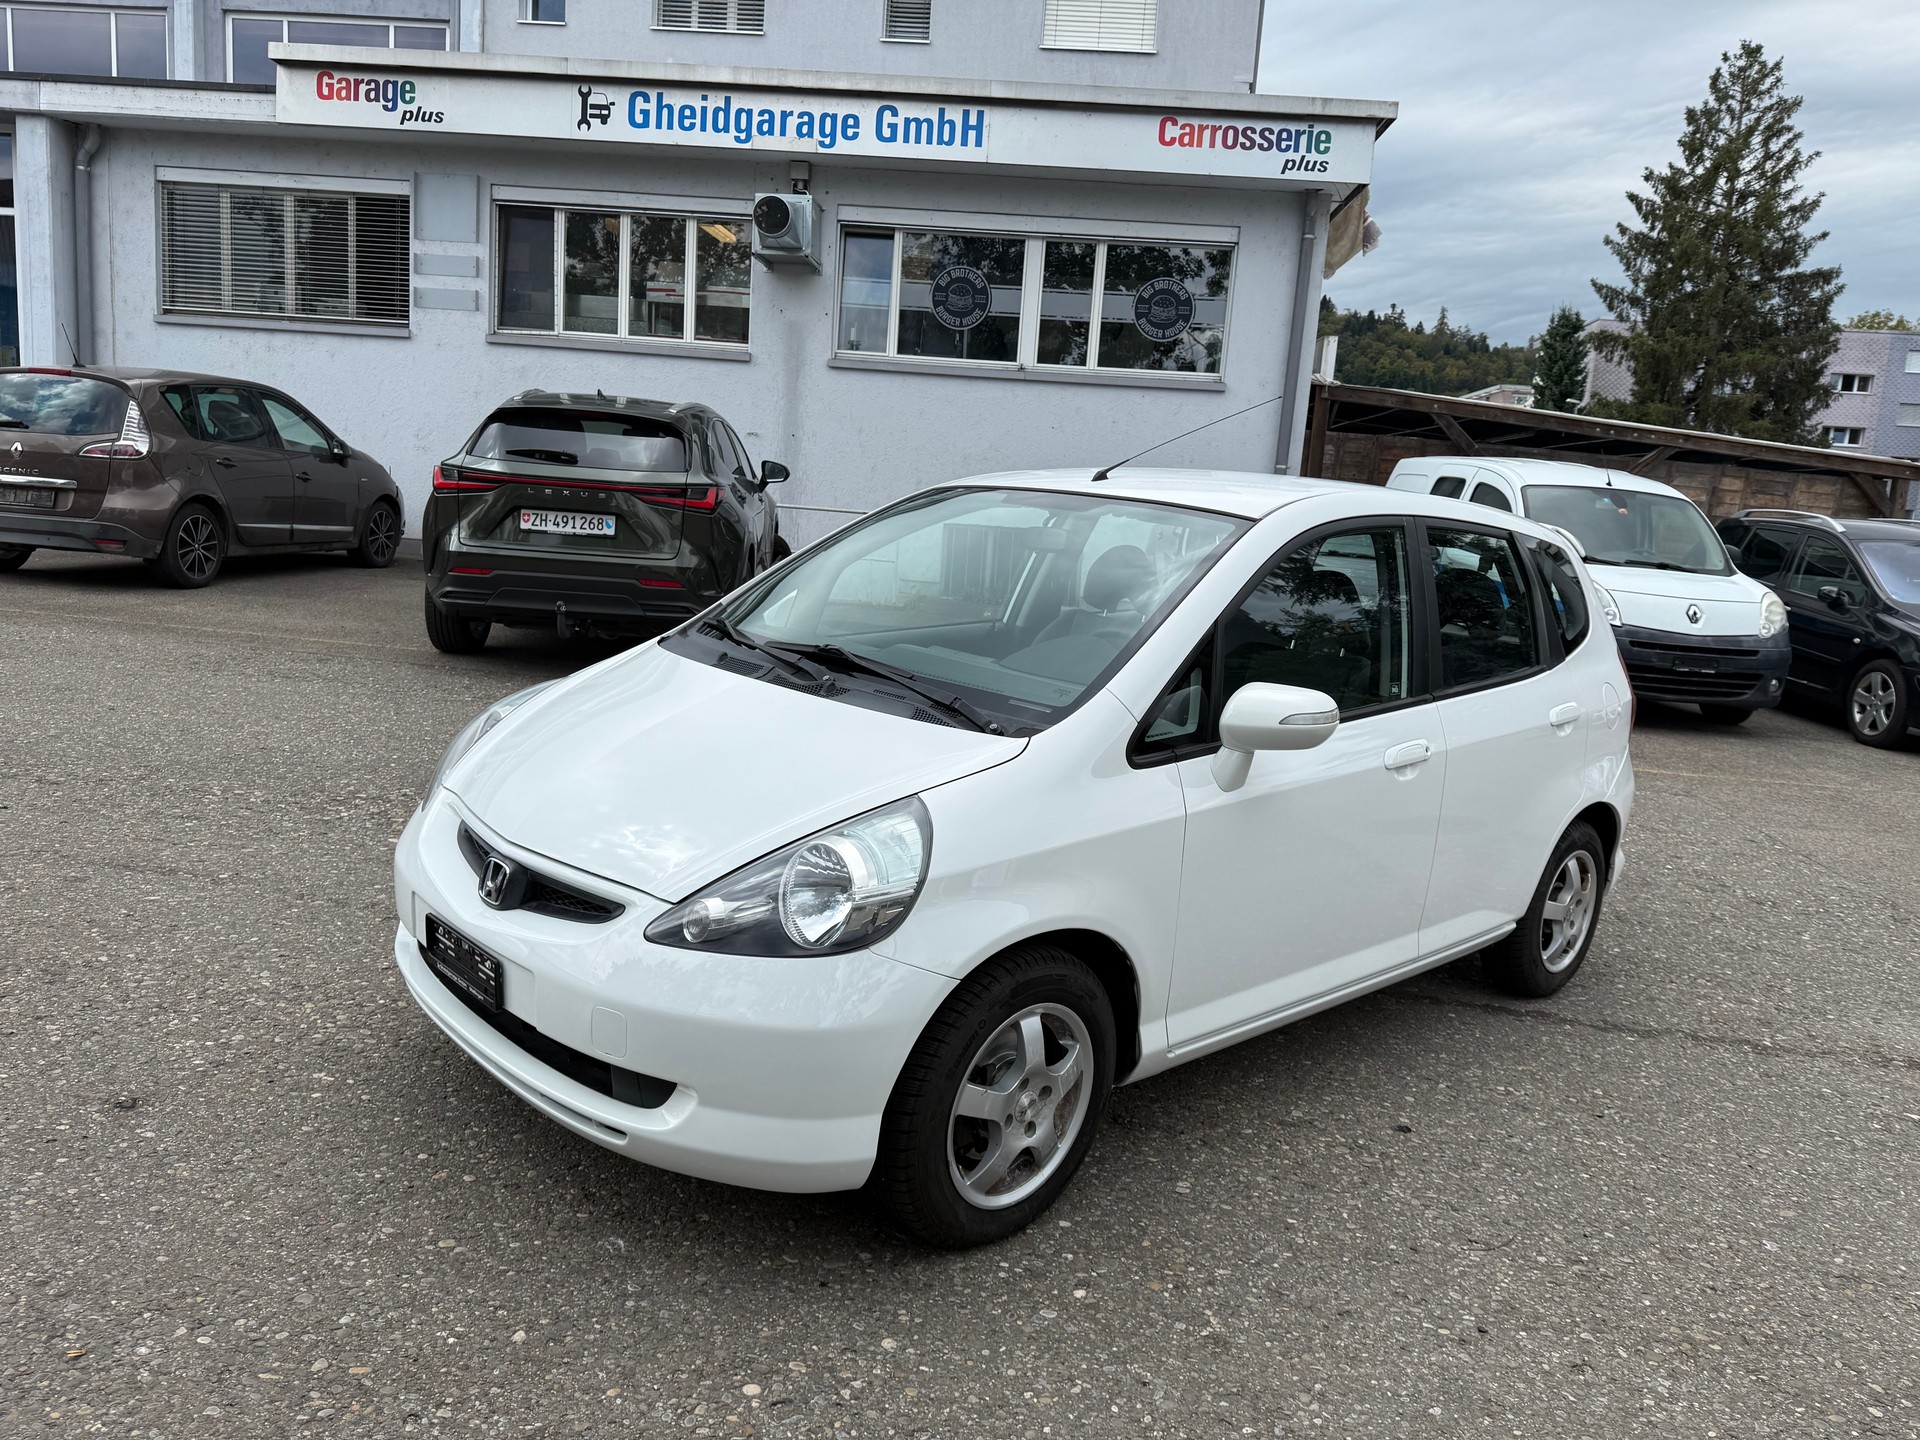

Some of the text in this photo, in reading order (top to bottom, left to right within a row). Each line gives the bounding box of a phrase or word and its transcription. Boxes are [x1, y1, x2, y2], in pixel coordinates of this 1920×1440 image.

[316, 70, 416, 112] Garage
[400, 106, 445, 125] plus
[627, 91, 985, 149] Gheidgarage GmbH
[1158, 116, 1332, 154] Carrosserie
[1280, 155, 1329, 174] plus
[938, 268, 985, 289] BIG BROTHERS
[1141, 280, 1189, 300] BIG BROTHERS
[935, 305, 984, 326] BURGER HOUSE
[1138, 317, 1187, 338] BURGER HOUSE
[0, 466, 39, 475] CENIC
[528, 487, 606, 498] LEXUS
